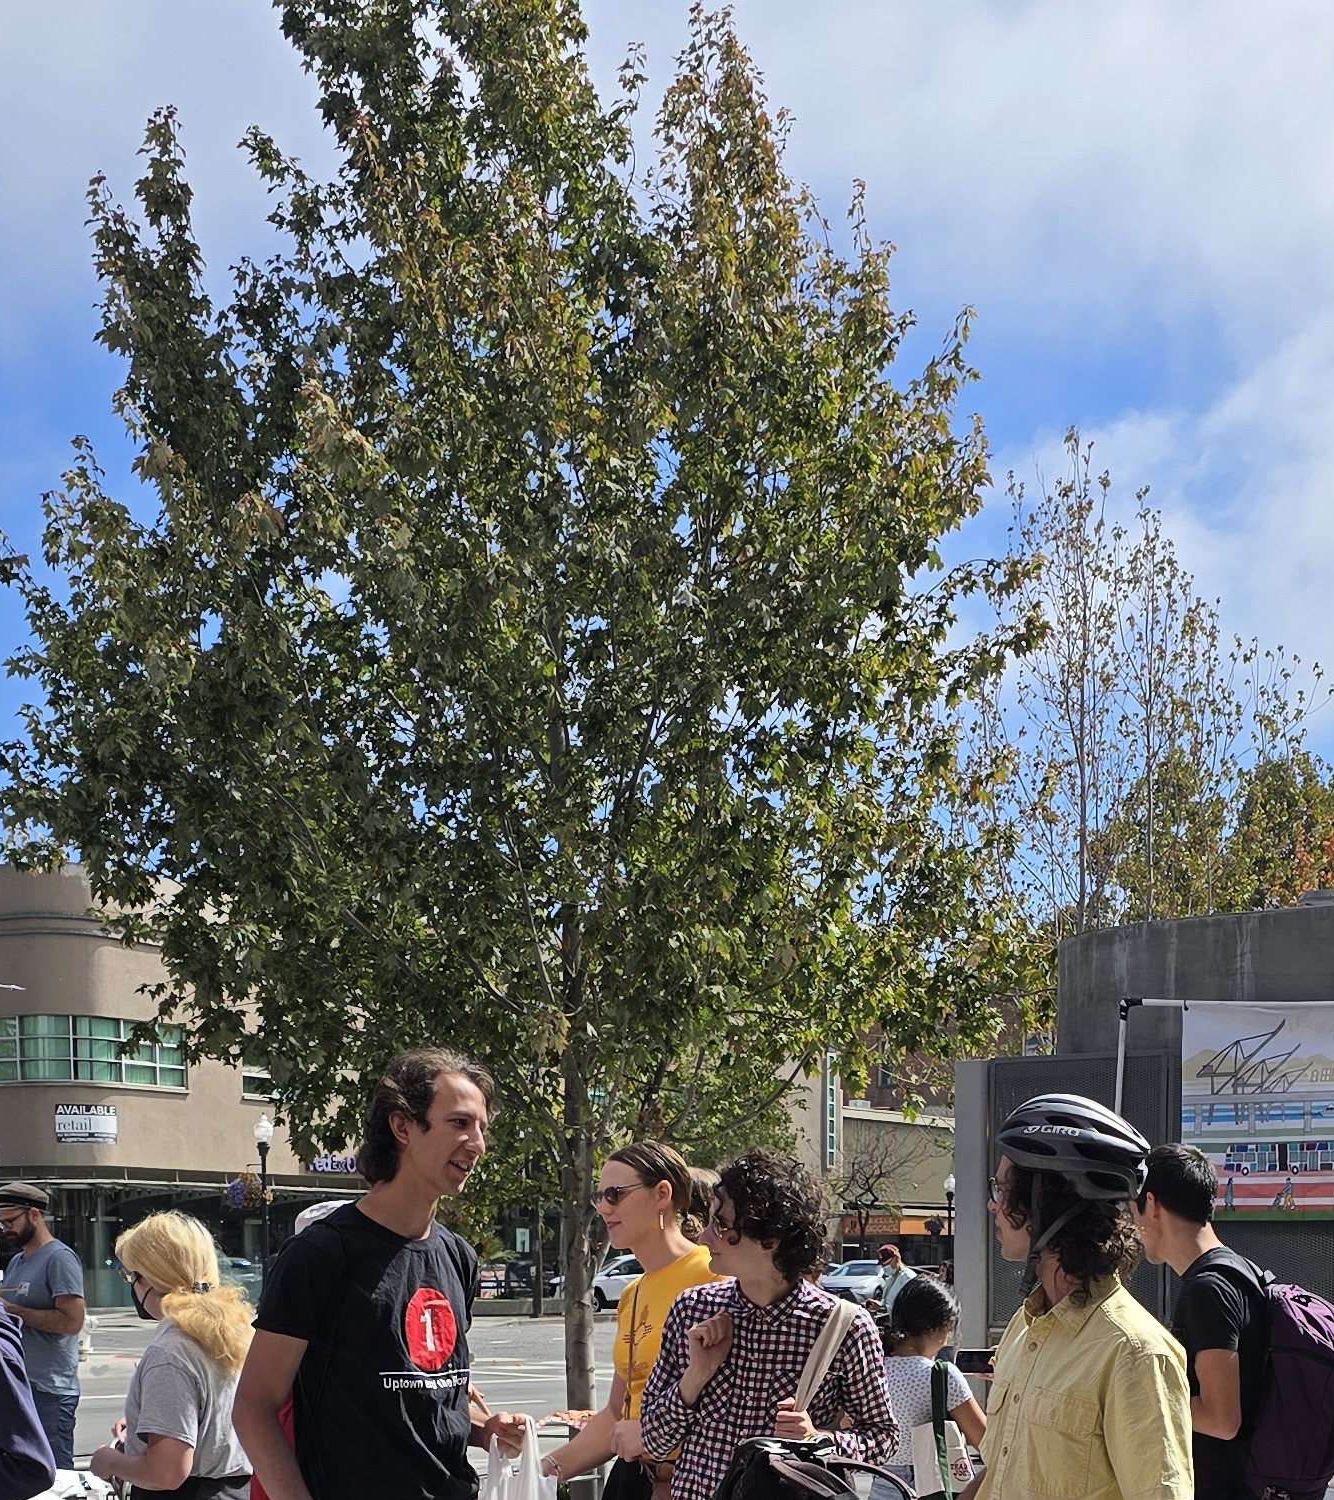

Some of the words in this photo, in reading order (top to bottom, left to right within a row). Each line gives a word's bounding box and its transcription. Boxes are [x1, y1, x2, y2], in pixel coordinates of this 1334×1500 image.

[56, 1104, 116, 1116] AVAILABLE
[57, 1117, 92, 1131] retail
[1040, 1124, 1081, 1137] GIRO
[420, 1308, 436, 1352] 1
[383, 1377, 424, 1392] Uptown
